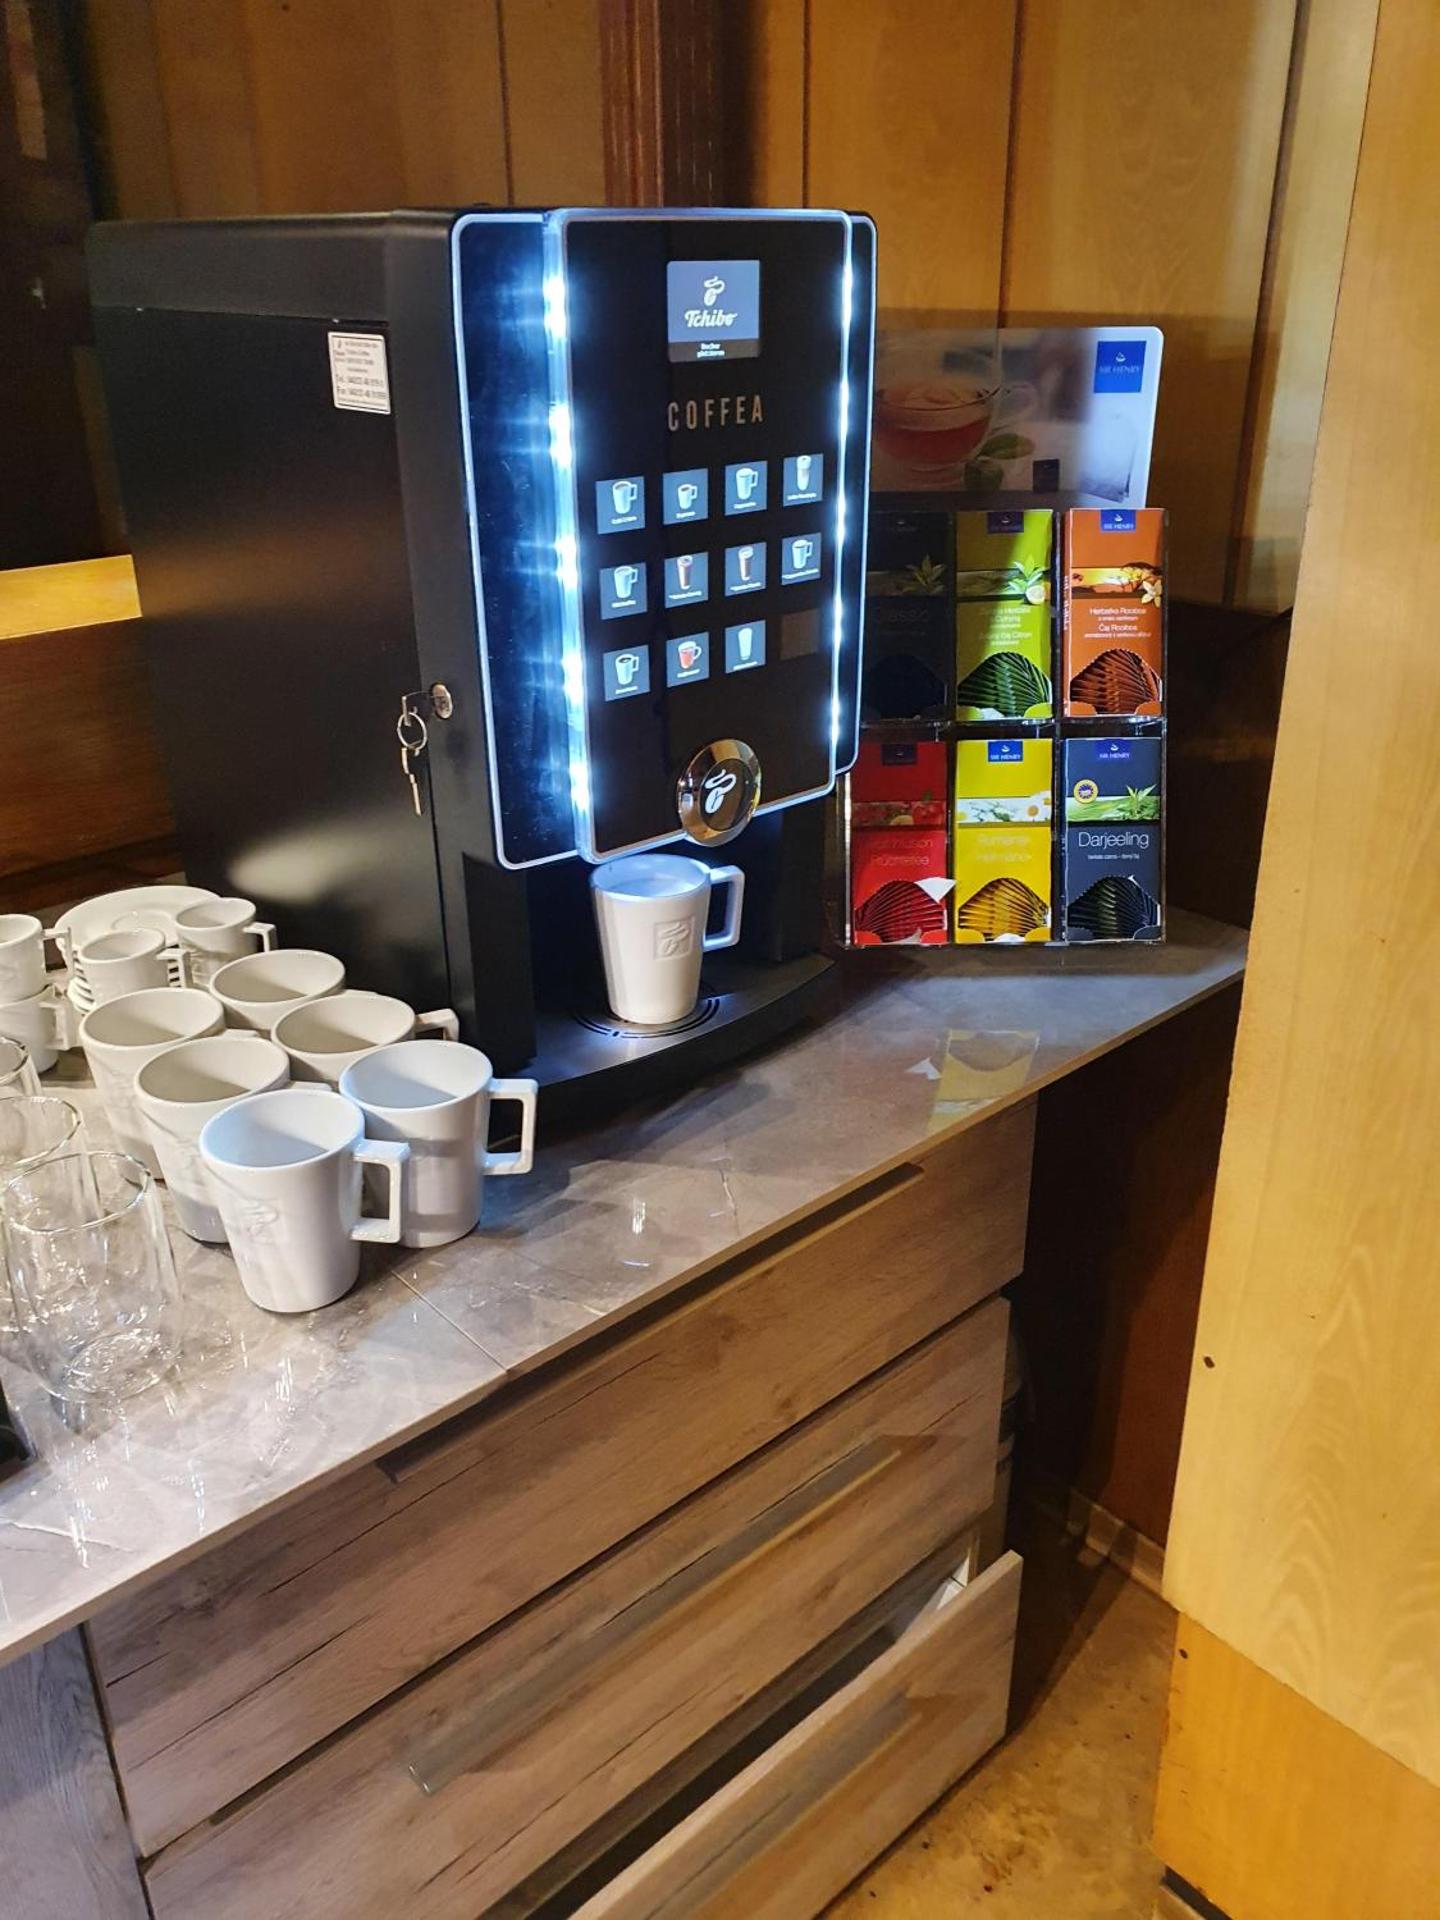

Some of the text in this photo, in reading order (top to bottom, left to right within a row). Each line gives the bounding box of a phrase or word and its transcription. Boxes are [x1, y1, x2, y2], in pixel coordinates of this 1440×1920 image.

[684, 309, 738, 328] Tchibo
[667, 394, 763, 432] COFFEA
[1078, 831, 1150, 850] Darjeeling
